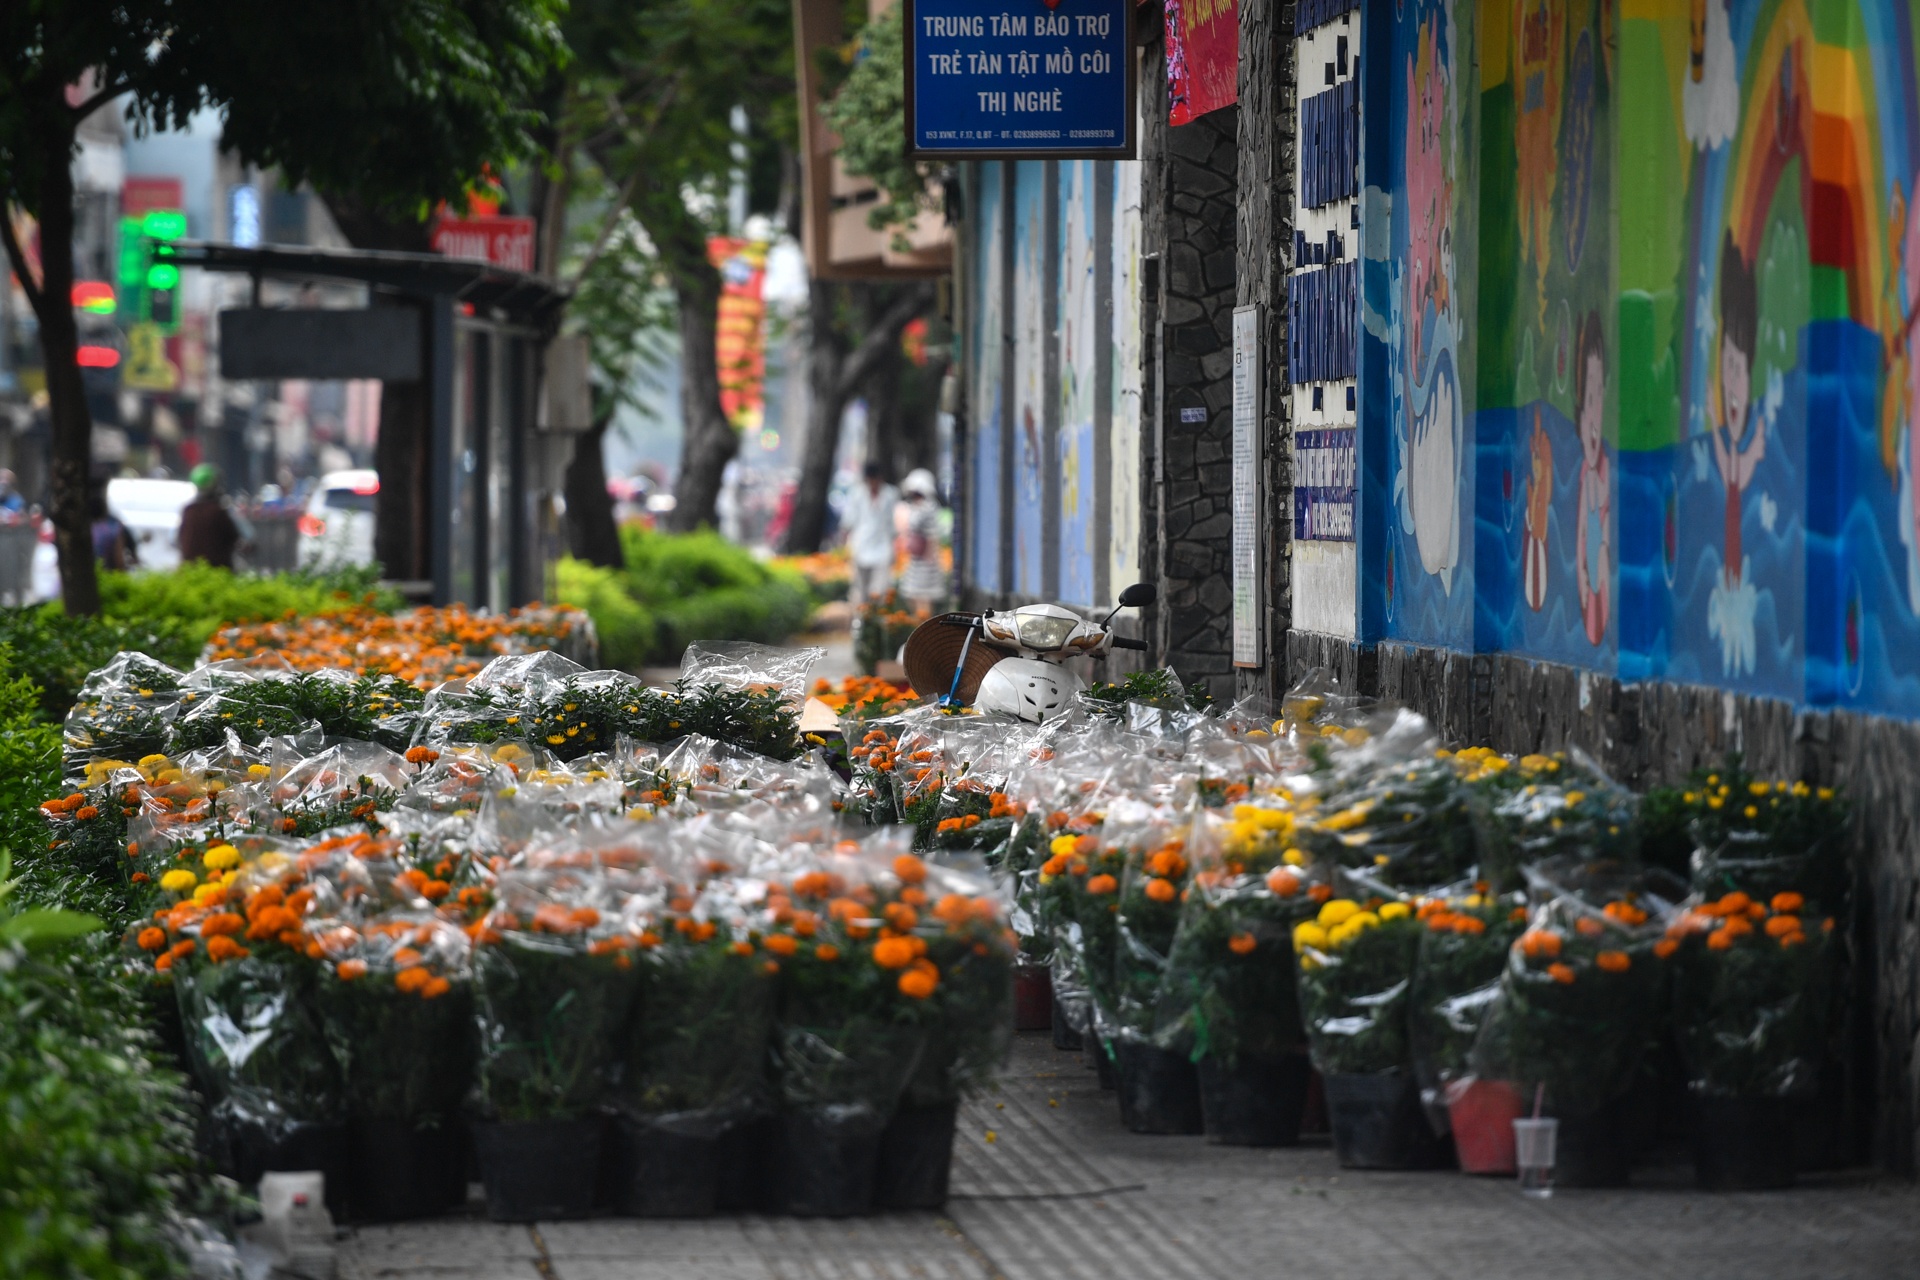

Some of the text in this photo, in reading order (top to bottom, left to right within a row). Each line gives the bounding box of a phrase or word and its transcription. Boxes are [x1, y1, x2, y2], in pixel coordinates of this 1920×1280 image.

[923, 11, 1110, 39] TRUNG TÂM BẢO TRỢ
[929, 46, 1110, 78] TRẺ TÀN TẬT MỒ CÔI
[977, 88, 1062, 116] THỊ NGHÈ
[1031, 675, 1056, 685] HONDA
